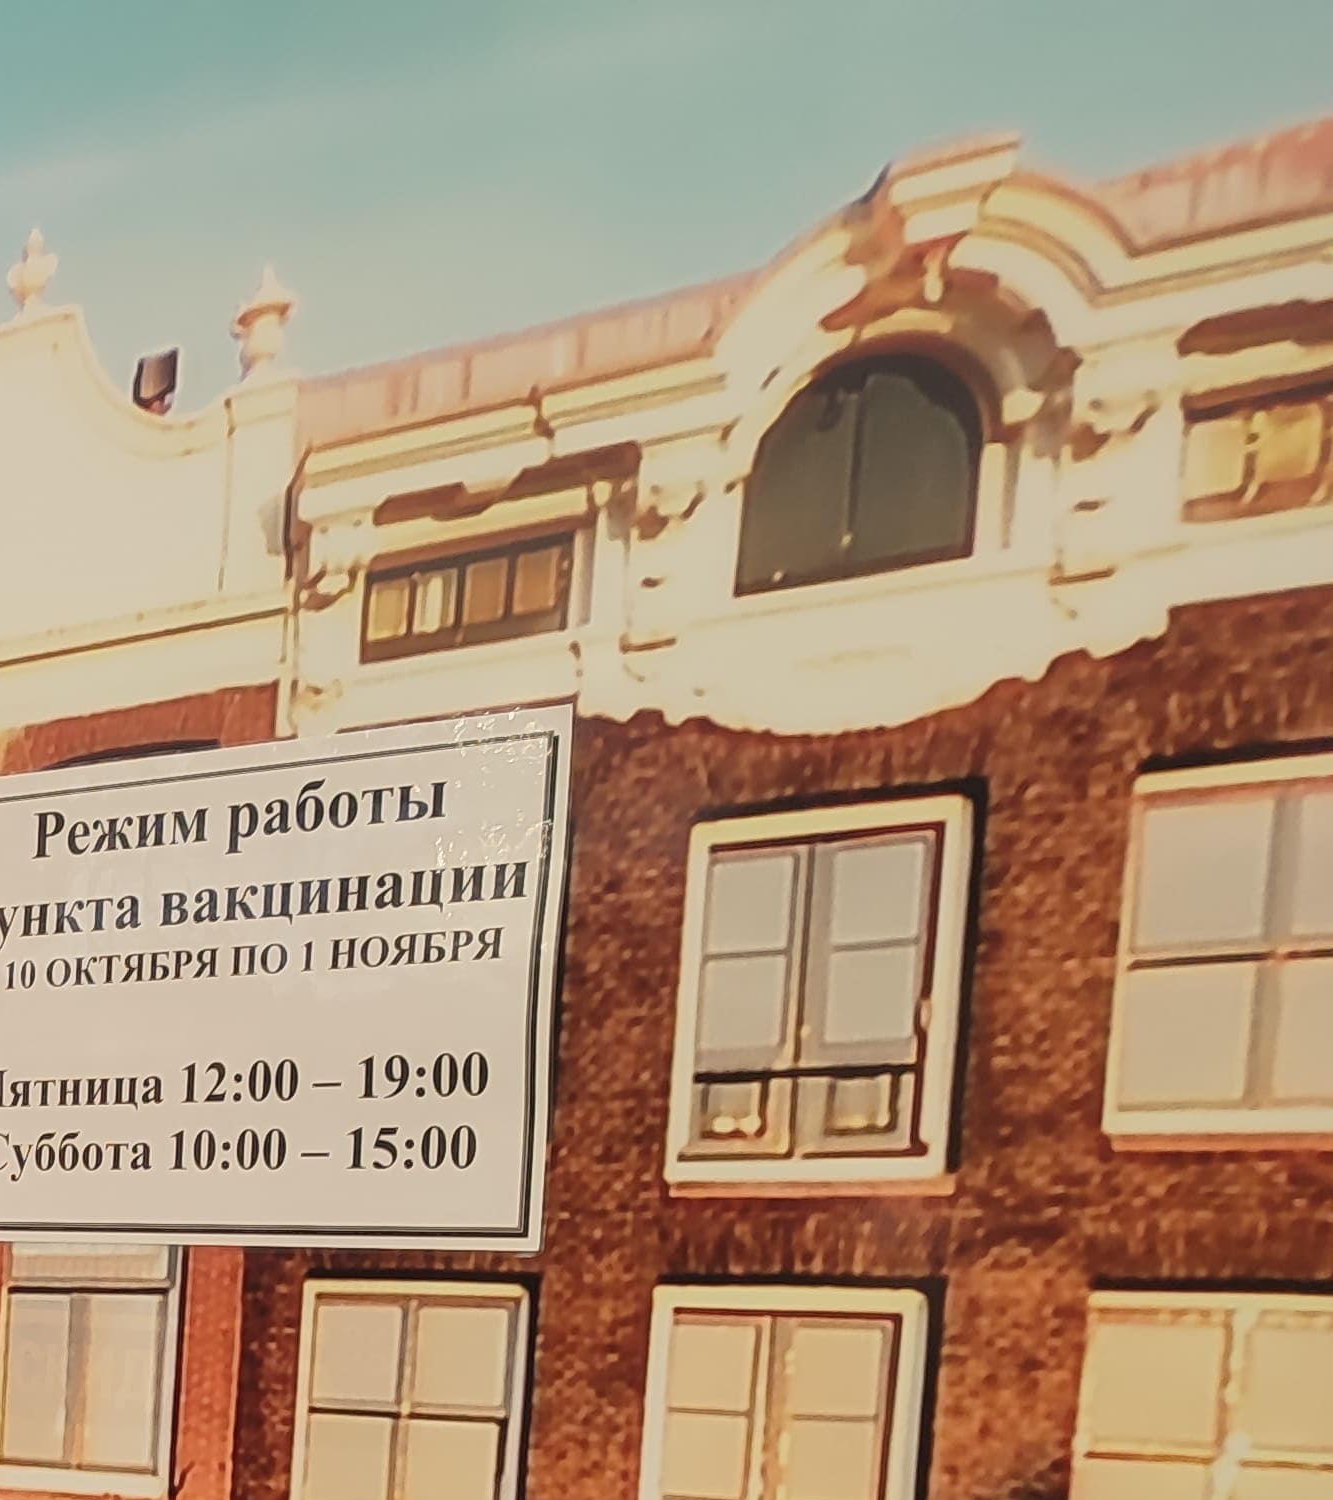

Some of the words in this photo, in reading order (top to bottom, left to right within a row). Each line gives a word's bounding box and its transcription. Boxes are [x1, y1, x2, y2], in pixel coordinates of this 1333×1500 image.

[32, 807, 209, 860] Режим
[225, 778, 447, 855] работы
[159, 859, 528, 927] вакцинации
[6, 960, 36, 990] 10
[46, 947, 219, 988] ОКТЯБРЯ
[230, 943, 288, 977] ПО
[302, 941, 313, 972] 1
[329, 927, 504, 970] НОЯБРЯ
[181, 1058, 299, 1104] 12:00
[358, 1051, 489, 1099] 19:00
[170, 1128, 287, 1171] 10:00
[347, 1124, 477, 1170] 15:00
